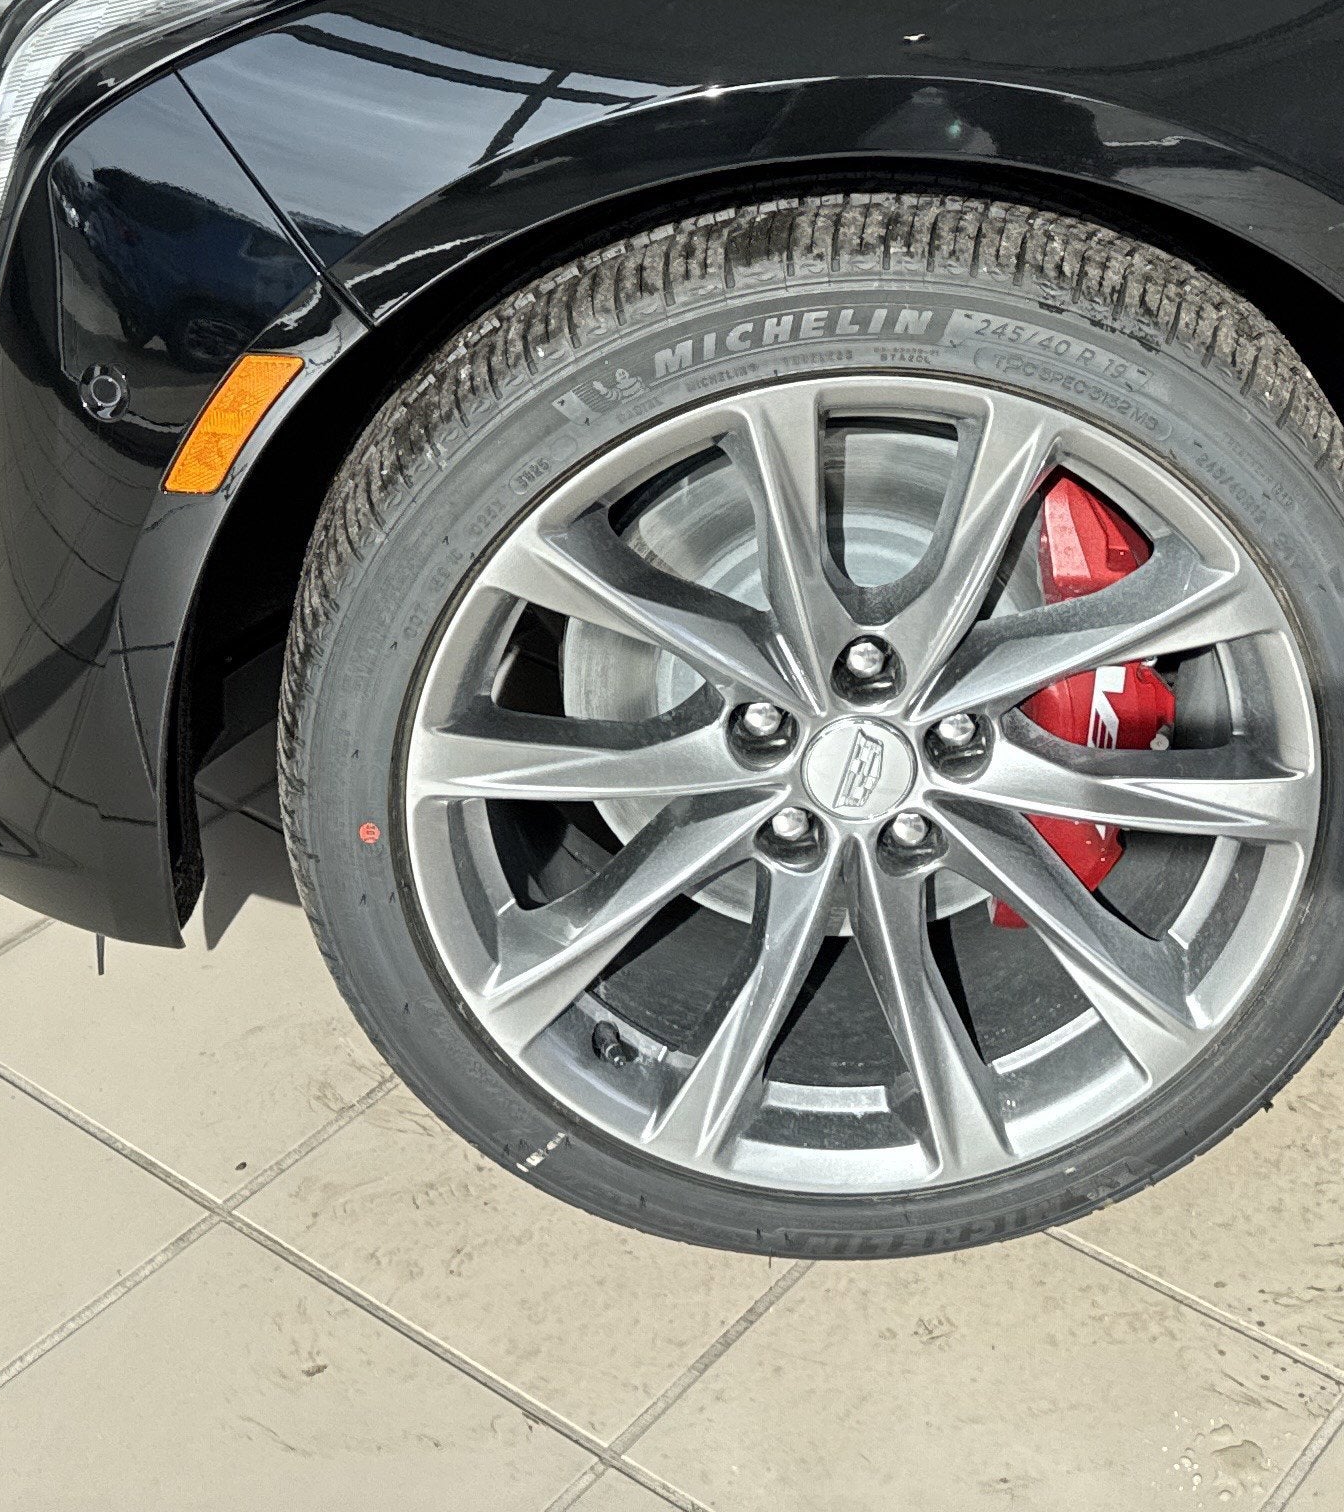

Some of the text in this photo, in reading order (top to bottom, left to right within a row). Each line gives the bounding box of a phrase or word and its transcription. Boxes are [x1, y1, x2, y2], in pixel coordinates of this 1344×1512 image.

[654, 308, 934, 378] MICHELIN
[974, 319, 1071, 356] 245/40
[1104, 358, 1128, 379] 19
